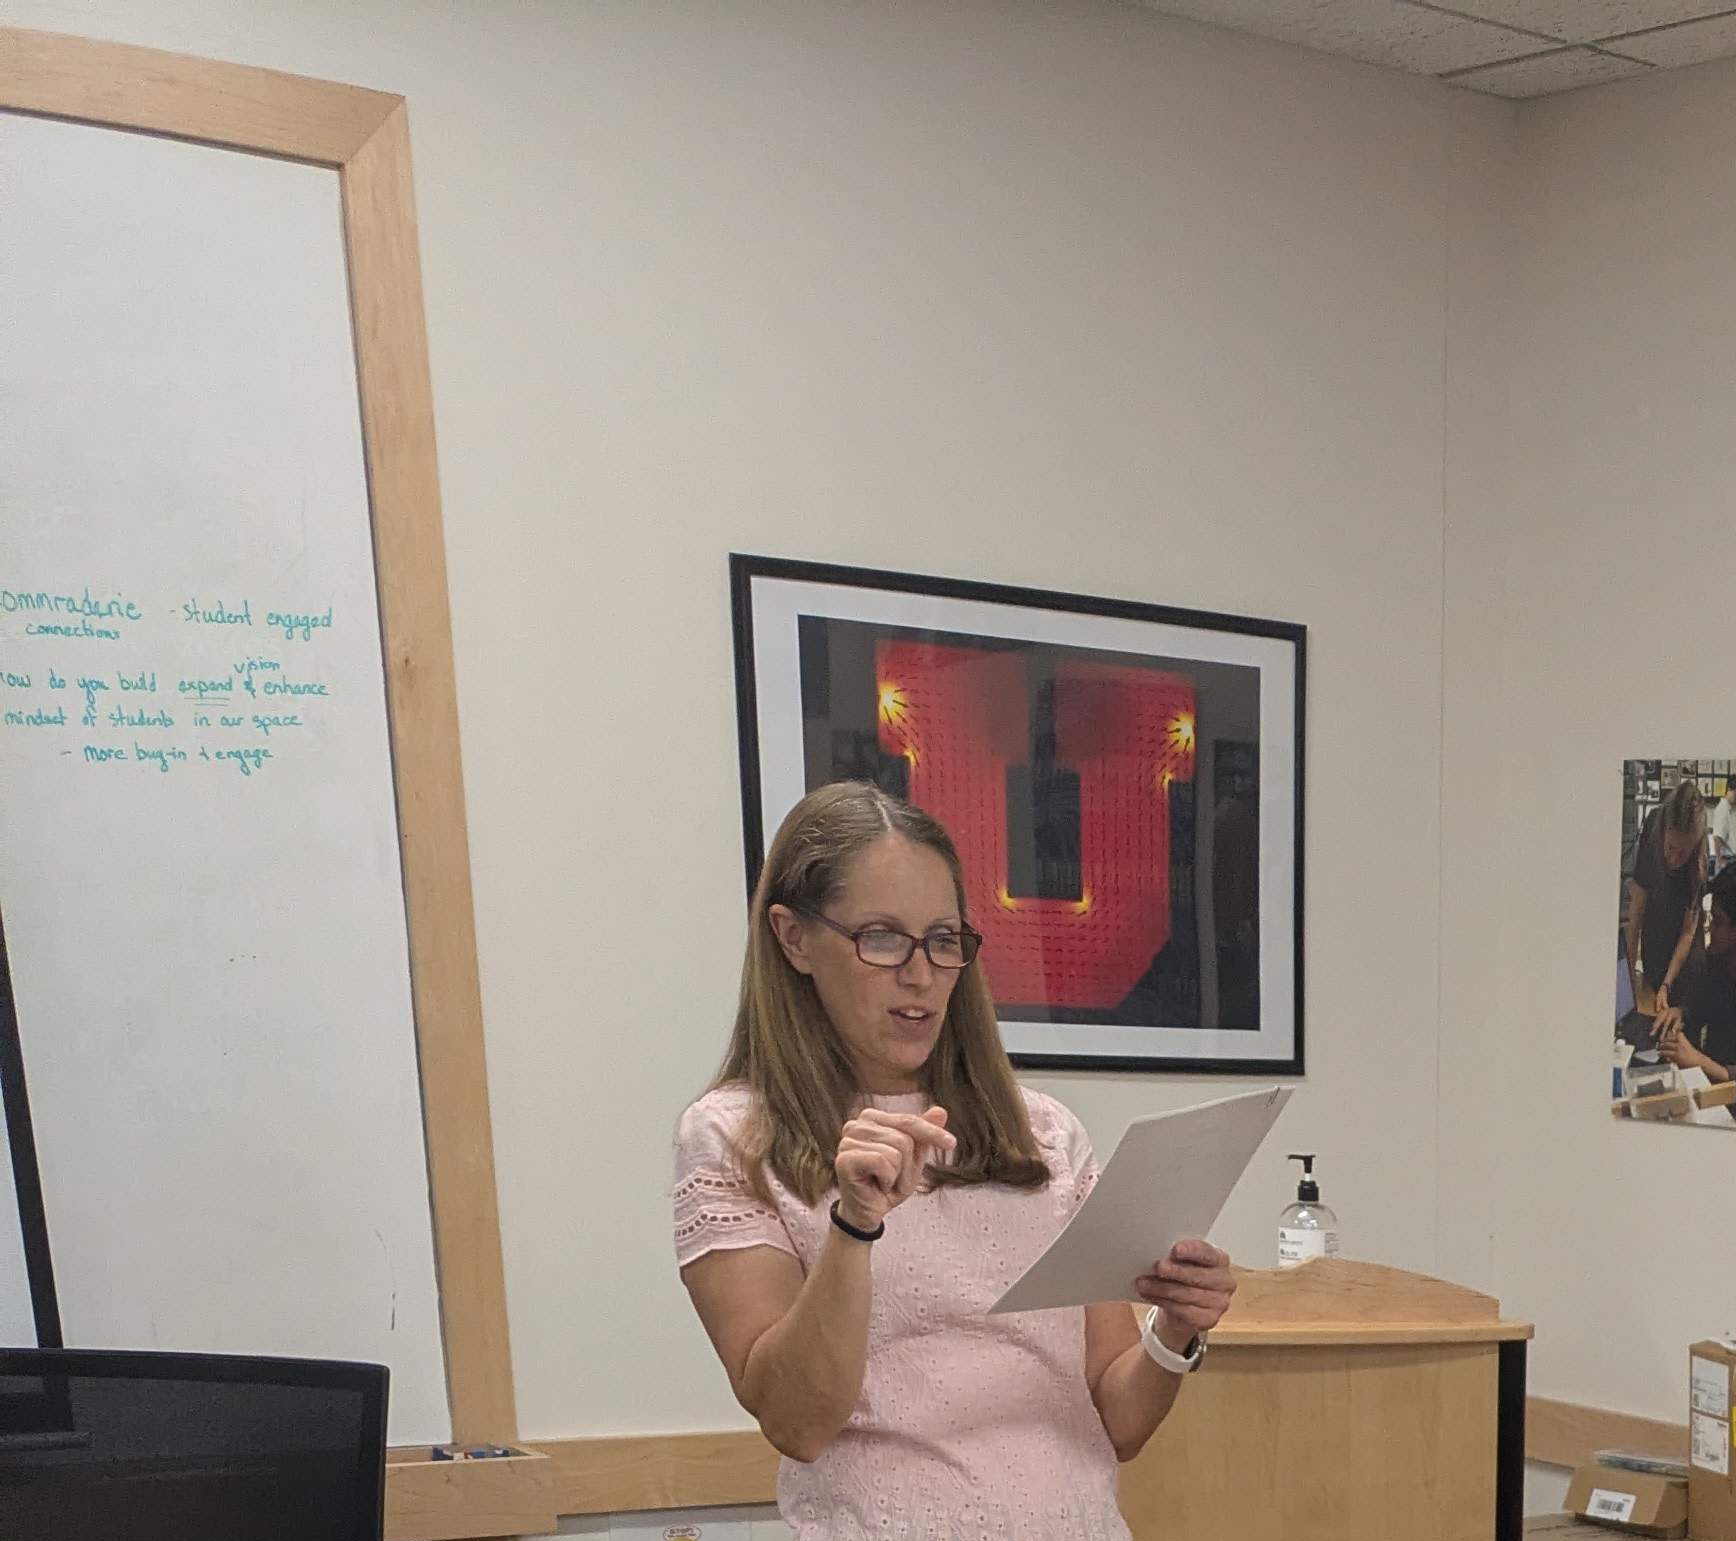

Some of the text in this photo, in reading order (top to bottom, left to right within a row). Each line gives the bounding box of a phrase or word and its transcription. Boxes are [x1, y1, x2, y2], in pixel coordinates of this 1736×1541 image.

[25, 619, 121, 640] connections
[266, 607, 333, 641] engaged
[0, 671, 31, 688] ow
[48, 668, 67, 689] do
[77, 677, 109, 704] you
[117, 671, 157, 692] build
[178, 677, 234, 699] expand
[263, 675, 330, 695] enhance
[4, 702, 303, 736] mindset of students in our space
[215, 747, 274, 776] engage
